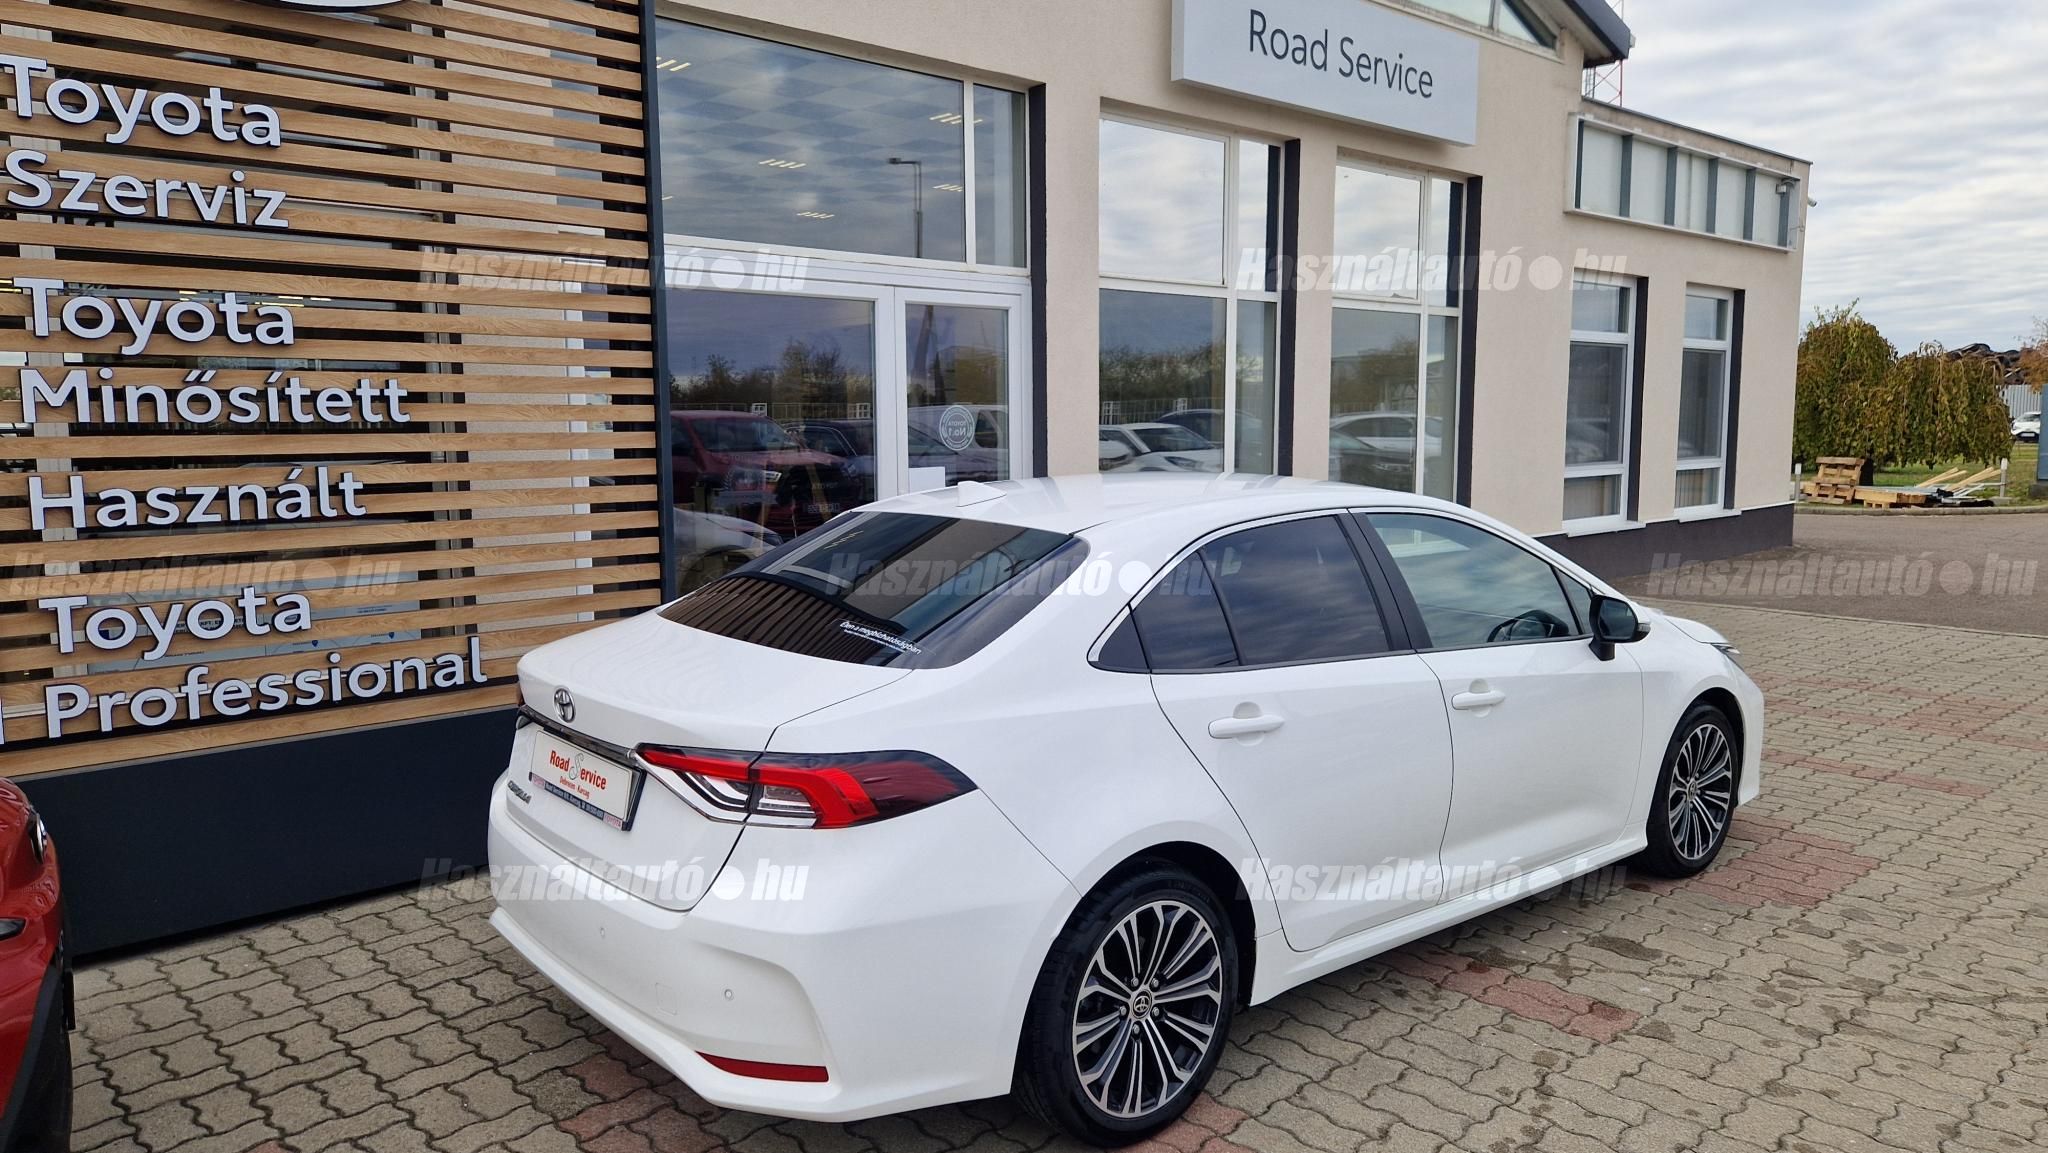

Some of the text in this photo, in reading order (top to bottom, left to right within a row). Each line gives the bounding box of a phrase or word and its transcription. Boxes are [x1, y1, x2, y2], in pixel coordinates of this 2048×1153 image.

[1249, 9, 1433, 99] Road Service
[0, 53, 282, 148] Toyota
[5, 149, 290, 229] Szerviz
[13, 276, 296, 356] Toyota
[19, 367, 411, 424] Minősített
[27, 466, 367, 531] Használt
[38, 586, 313, 661] Toyota
[44, 636, 489, 739] Professional
[549, 750, 570, 772] Road
